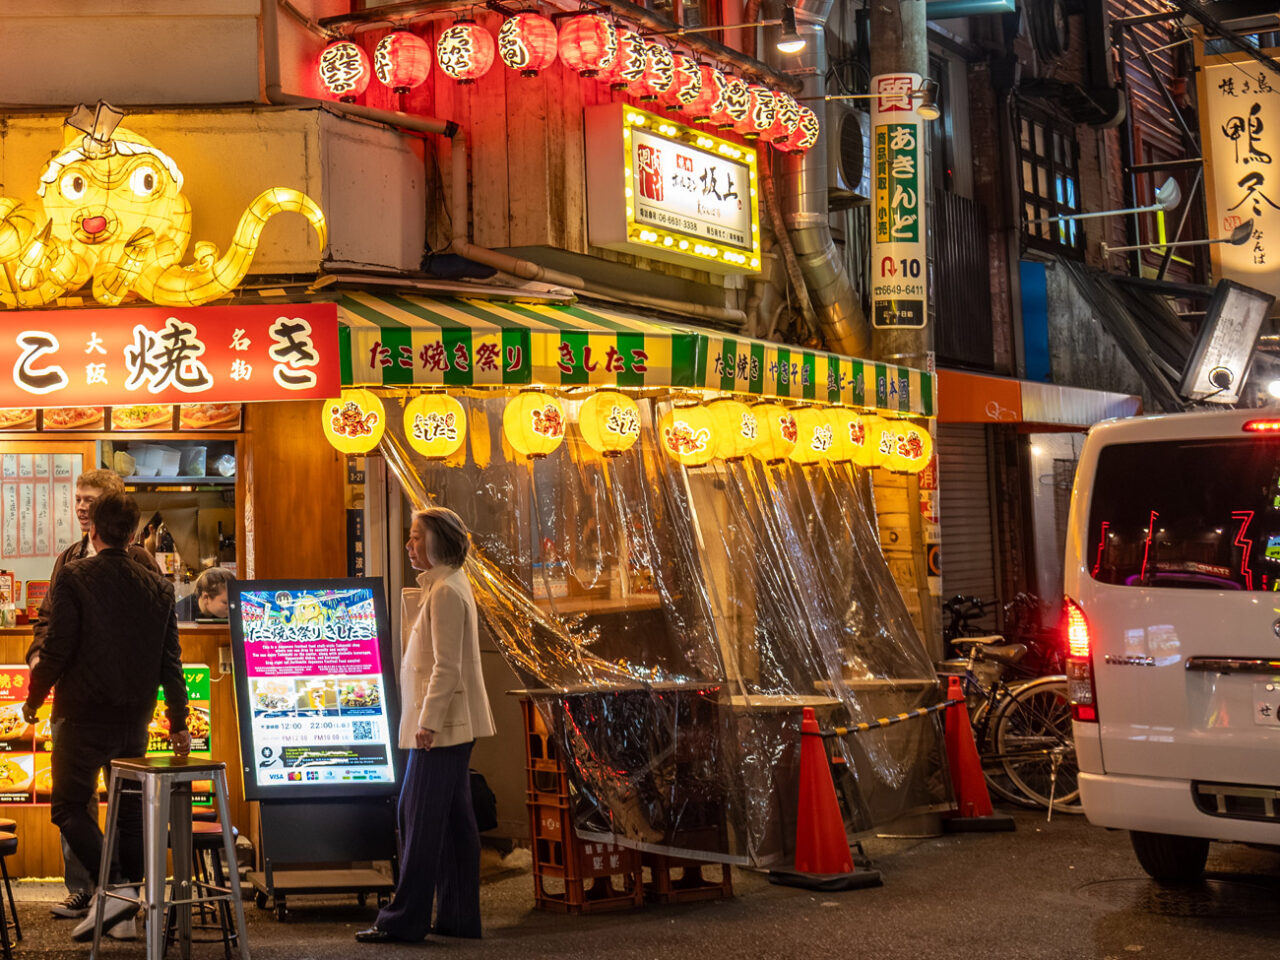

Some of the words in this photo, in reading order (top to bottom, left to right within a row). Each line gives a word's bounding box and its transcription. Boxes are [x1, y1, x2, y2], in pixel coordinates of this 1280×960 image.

[878, 77, 914, 113] 質
[1218, 71, 1273, 98] 焼き鳥
[699, 166, 739, 201] 坂上
[890, 126, 918, 239] あきんど
[1252, 229, 1267, 265] なんば
[900, 258, 921, 279] 10
[882, 284, 924, 297] 6649-6411
[84, 331, 109, 386] 大阪
[228, 327, 253, 383] 名物
[369, 340, 525, 373] たこ焼き祭り
[557, 341, 649, 375] きしたこ
[714, 352, 759, 381] たこ焼き
[768, 359, 811, 387] やきそば
[878, 375, 910, 403] 日本酒
[412, 419, 457, 442] きしたこ
[249, 625, 321, 642] たこ焼き祭り
[324, 624, 373, 640] きしたこ
[1259, 704, 1272, 717] せ
